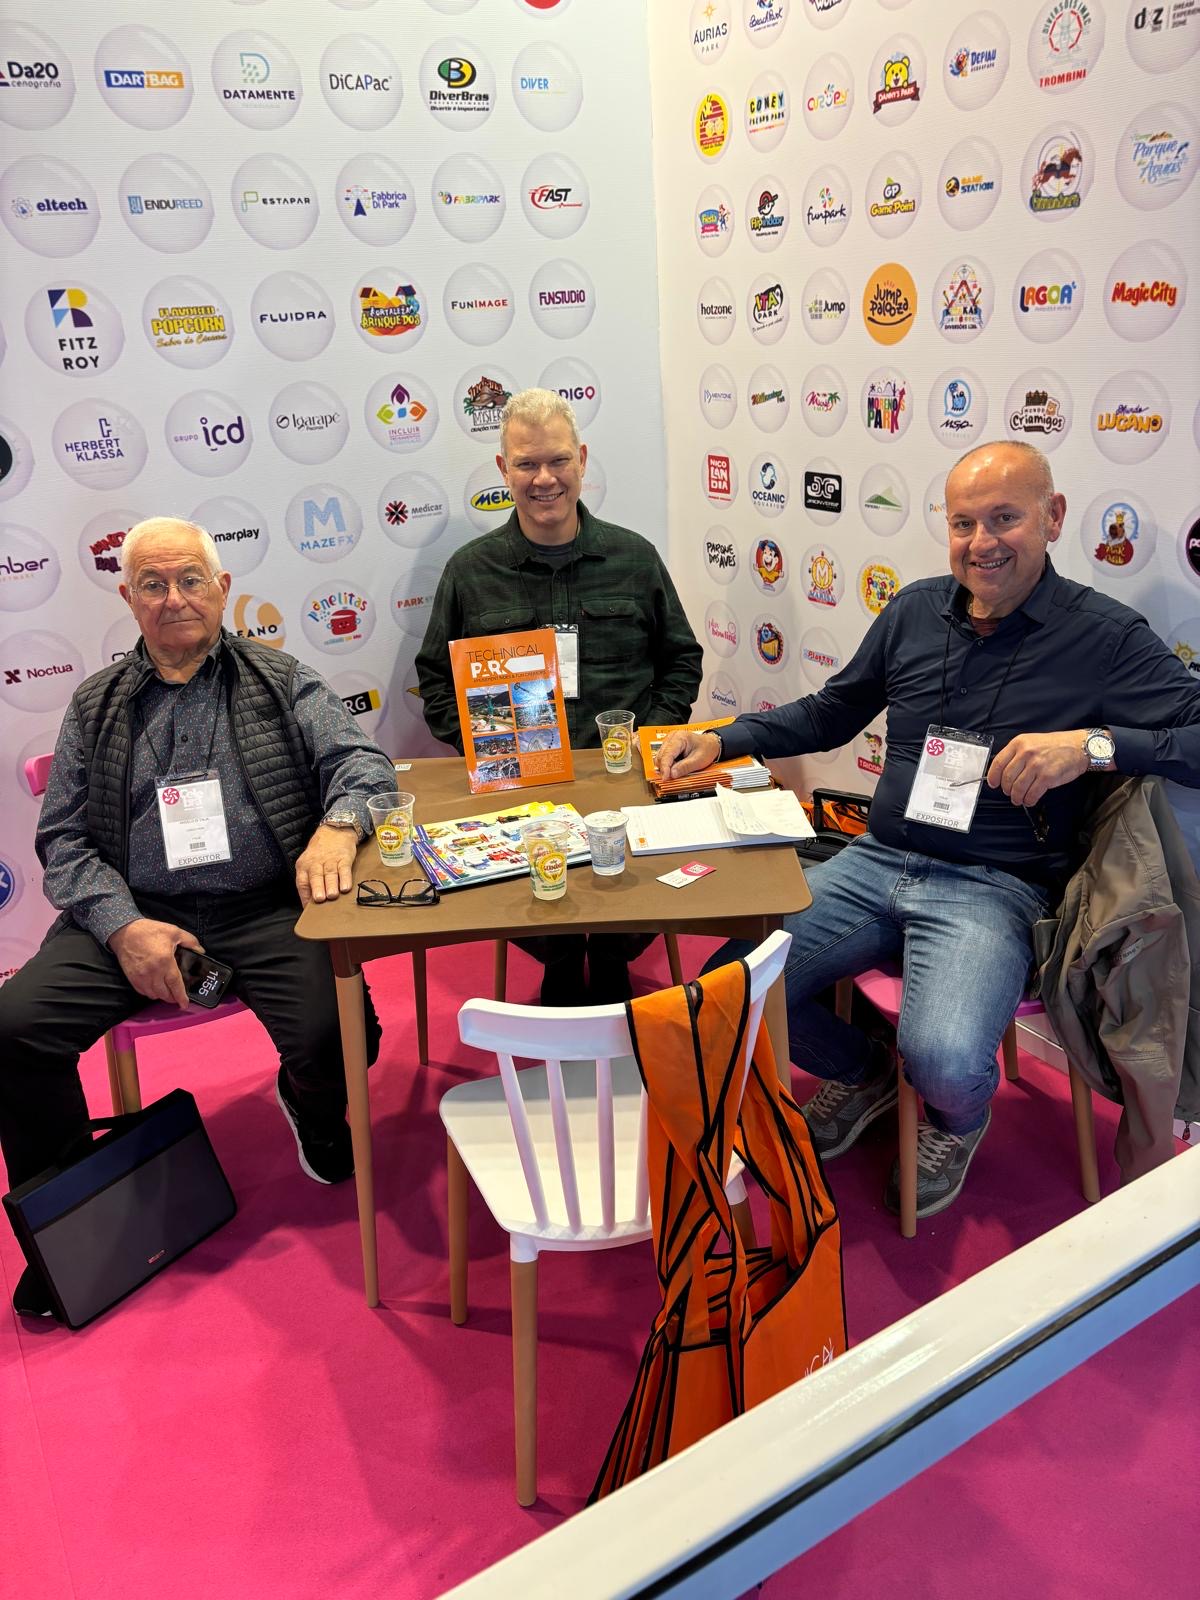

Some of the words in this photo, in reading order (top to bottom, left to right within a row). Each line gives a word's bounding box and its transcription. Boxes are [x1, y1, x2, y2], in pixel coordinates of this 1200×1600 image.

[693, 22, 728, 46] ÁURIAS
[6, 61, 59, 80] Da20
[11, 79, 62, 89] cenografia
[110, 72, 180, 87] DARTBAG
[328, 73, 391, 92] DiCAPac
[520, 76, 549, 91] DIVER
[1039, 68, 1087, 89] TROMBINI
[222, 89, 296, 101] DATAMENTE
[429, 90, 490, 102] DiverBras
[749, 90, 785, 114] CONEY
[262, 197, 311, 206] ESTAPAR
[370, 190, 407, 201] Fabbrica
[453, 195, 501, 205] FABRIPARK
[537, 188, 573, 203] FAST
[36, 198, 88, 212] eltech
[144, 199, 204, 211] ENDUREED
[372, 200, 382, 209] Di
[382, 200, 400, 209] Park
[870, 203, 894, 218] Game
[806, 203, 847, 225] funpark
[755, 292, 779, 312] ITA
[1020, 284, 1073, 312] LAGOA
[700, 302, 733, 316] hotzone
[757, 308, 778, 320] PARK
[823, 299, 846, 314] Jump
[259, 310, 327, 324] FLUIDRA
[151, 315, 226, 336] POPCORN
[58, 336, 98, 352] FITZ
[62, 355, 100, 371] ROY
[292, 411, 341, 430] Igarapé
[867, 406, 900, 434] PARK
[1011, 413, 1064, 432] Criamigos
[173, 433, 199, 443] GRUPO
[199, 415, 245, 447] icd
[388, 426, 421, 436] INCLUIR
[64, 437, 121, 452] HERBERT
[75, 448, 124, 463] KLASSA
[710, 459, 727, 469] NICO
[710, 467, 728, 480] LAN
[710, 480, 728, 491] DIA
[752, 490, 786, 504] OCEANIC
[411, 503, 443, 515] Medicar
[213, 527, 260, 543] marplay
[706, 541, 734, 555] PARQUE
[718, 554, 736, 569] AVES
[711, 628, 737, 646] bowling
[465, 643, 545, 663] TECHNICAL
[26, 662, 74, 681] Noctua
[711, 690, 737, 707] Snowland
[915, 812, 960, 828] EXPOSITOR
[178, 853, 221, 866] EXPOSITOR
[198, 970, 219, 997] 11:55
